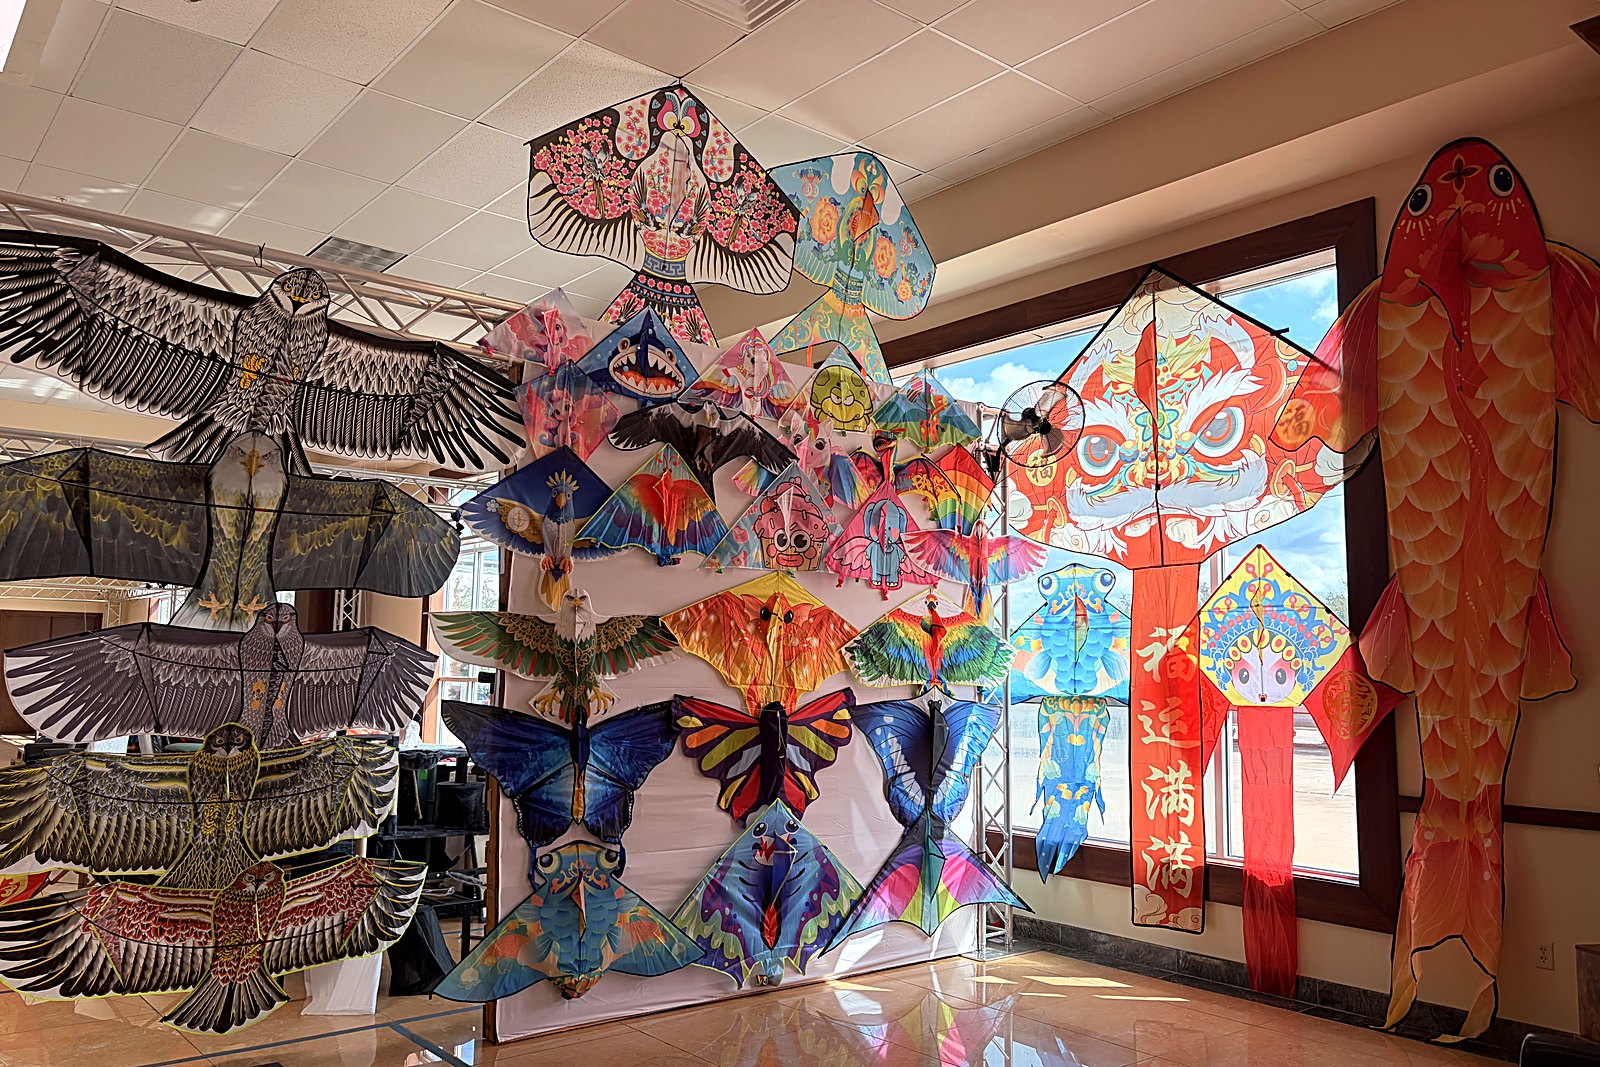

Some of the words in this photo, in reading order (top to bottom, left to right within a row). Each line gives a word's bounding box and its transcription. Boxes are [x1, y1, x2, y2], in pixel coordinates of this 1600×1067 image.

[1278, 403, 1310, 437] 福
[1136, 624, 1202, 898] 福运满满
